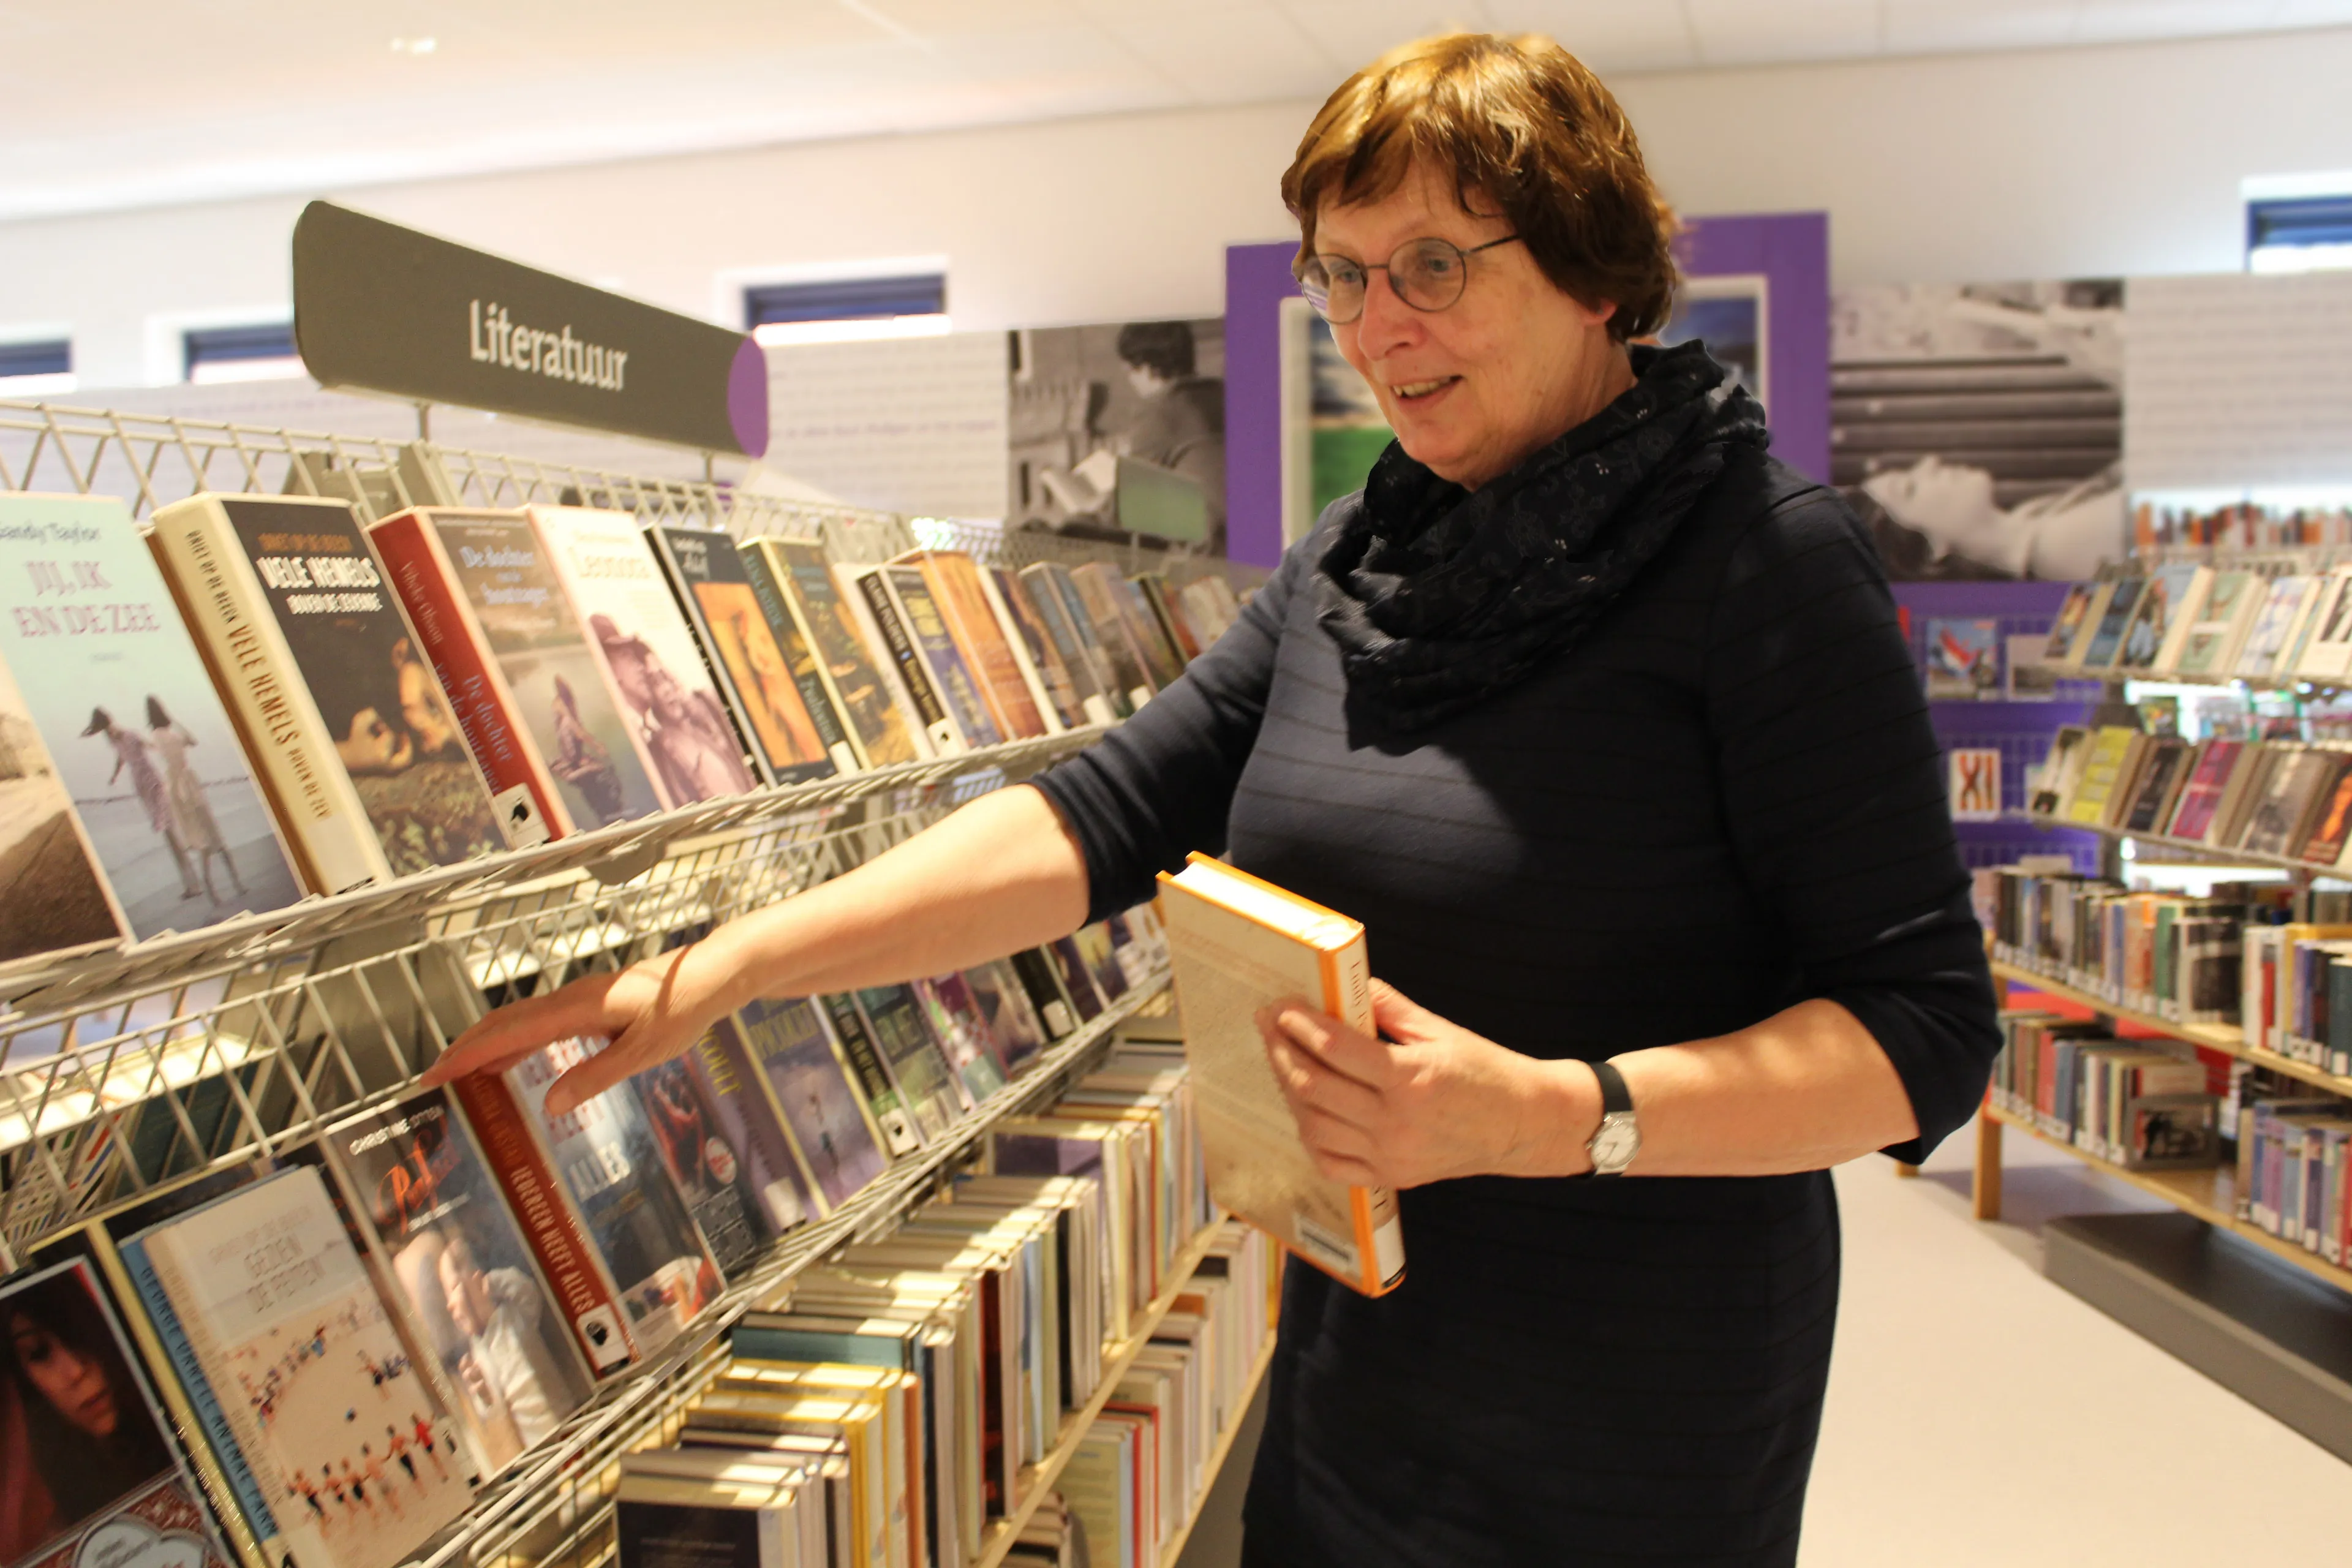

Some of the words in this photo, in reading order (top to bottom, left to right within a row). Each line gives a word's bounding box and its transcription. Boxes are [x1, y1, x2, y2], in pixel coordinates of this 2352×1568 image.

[469, 299, 628, 391] Literatuur
[255, 556, 314, 589] VELE
[306, 556, 381, 589] HEMELS
[12, 605, 62, 638] EN
[60, 603, 107, 636] DE
[102, 602, 161, 635] ZEE
[226, 622, 268, 673] VELE
[248, 671, 300, 746] HEMELS
[308, 795, 334, 821] ZEV
[540, 1225, 576, 1274] HEEFT
[559, 1264, 596, 1314] ALLES
